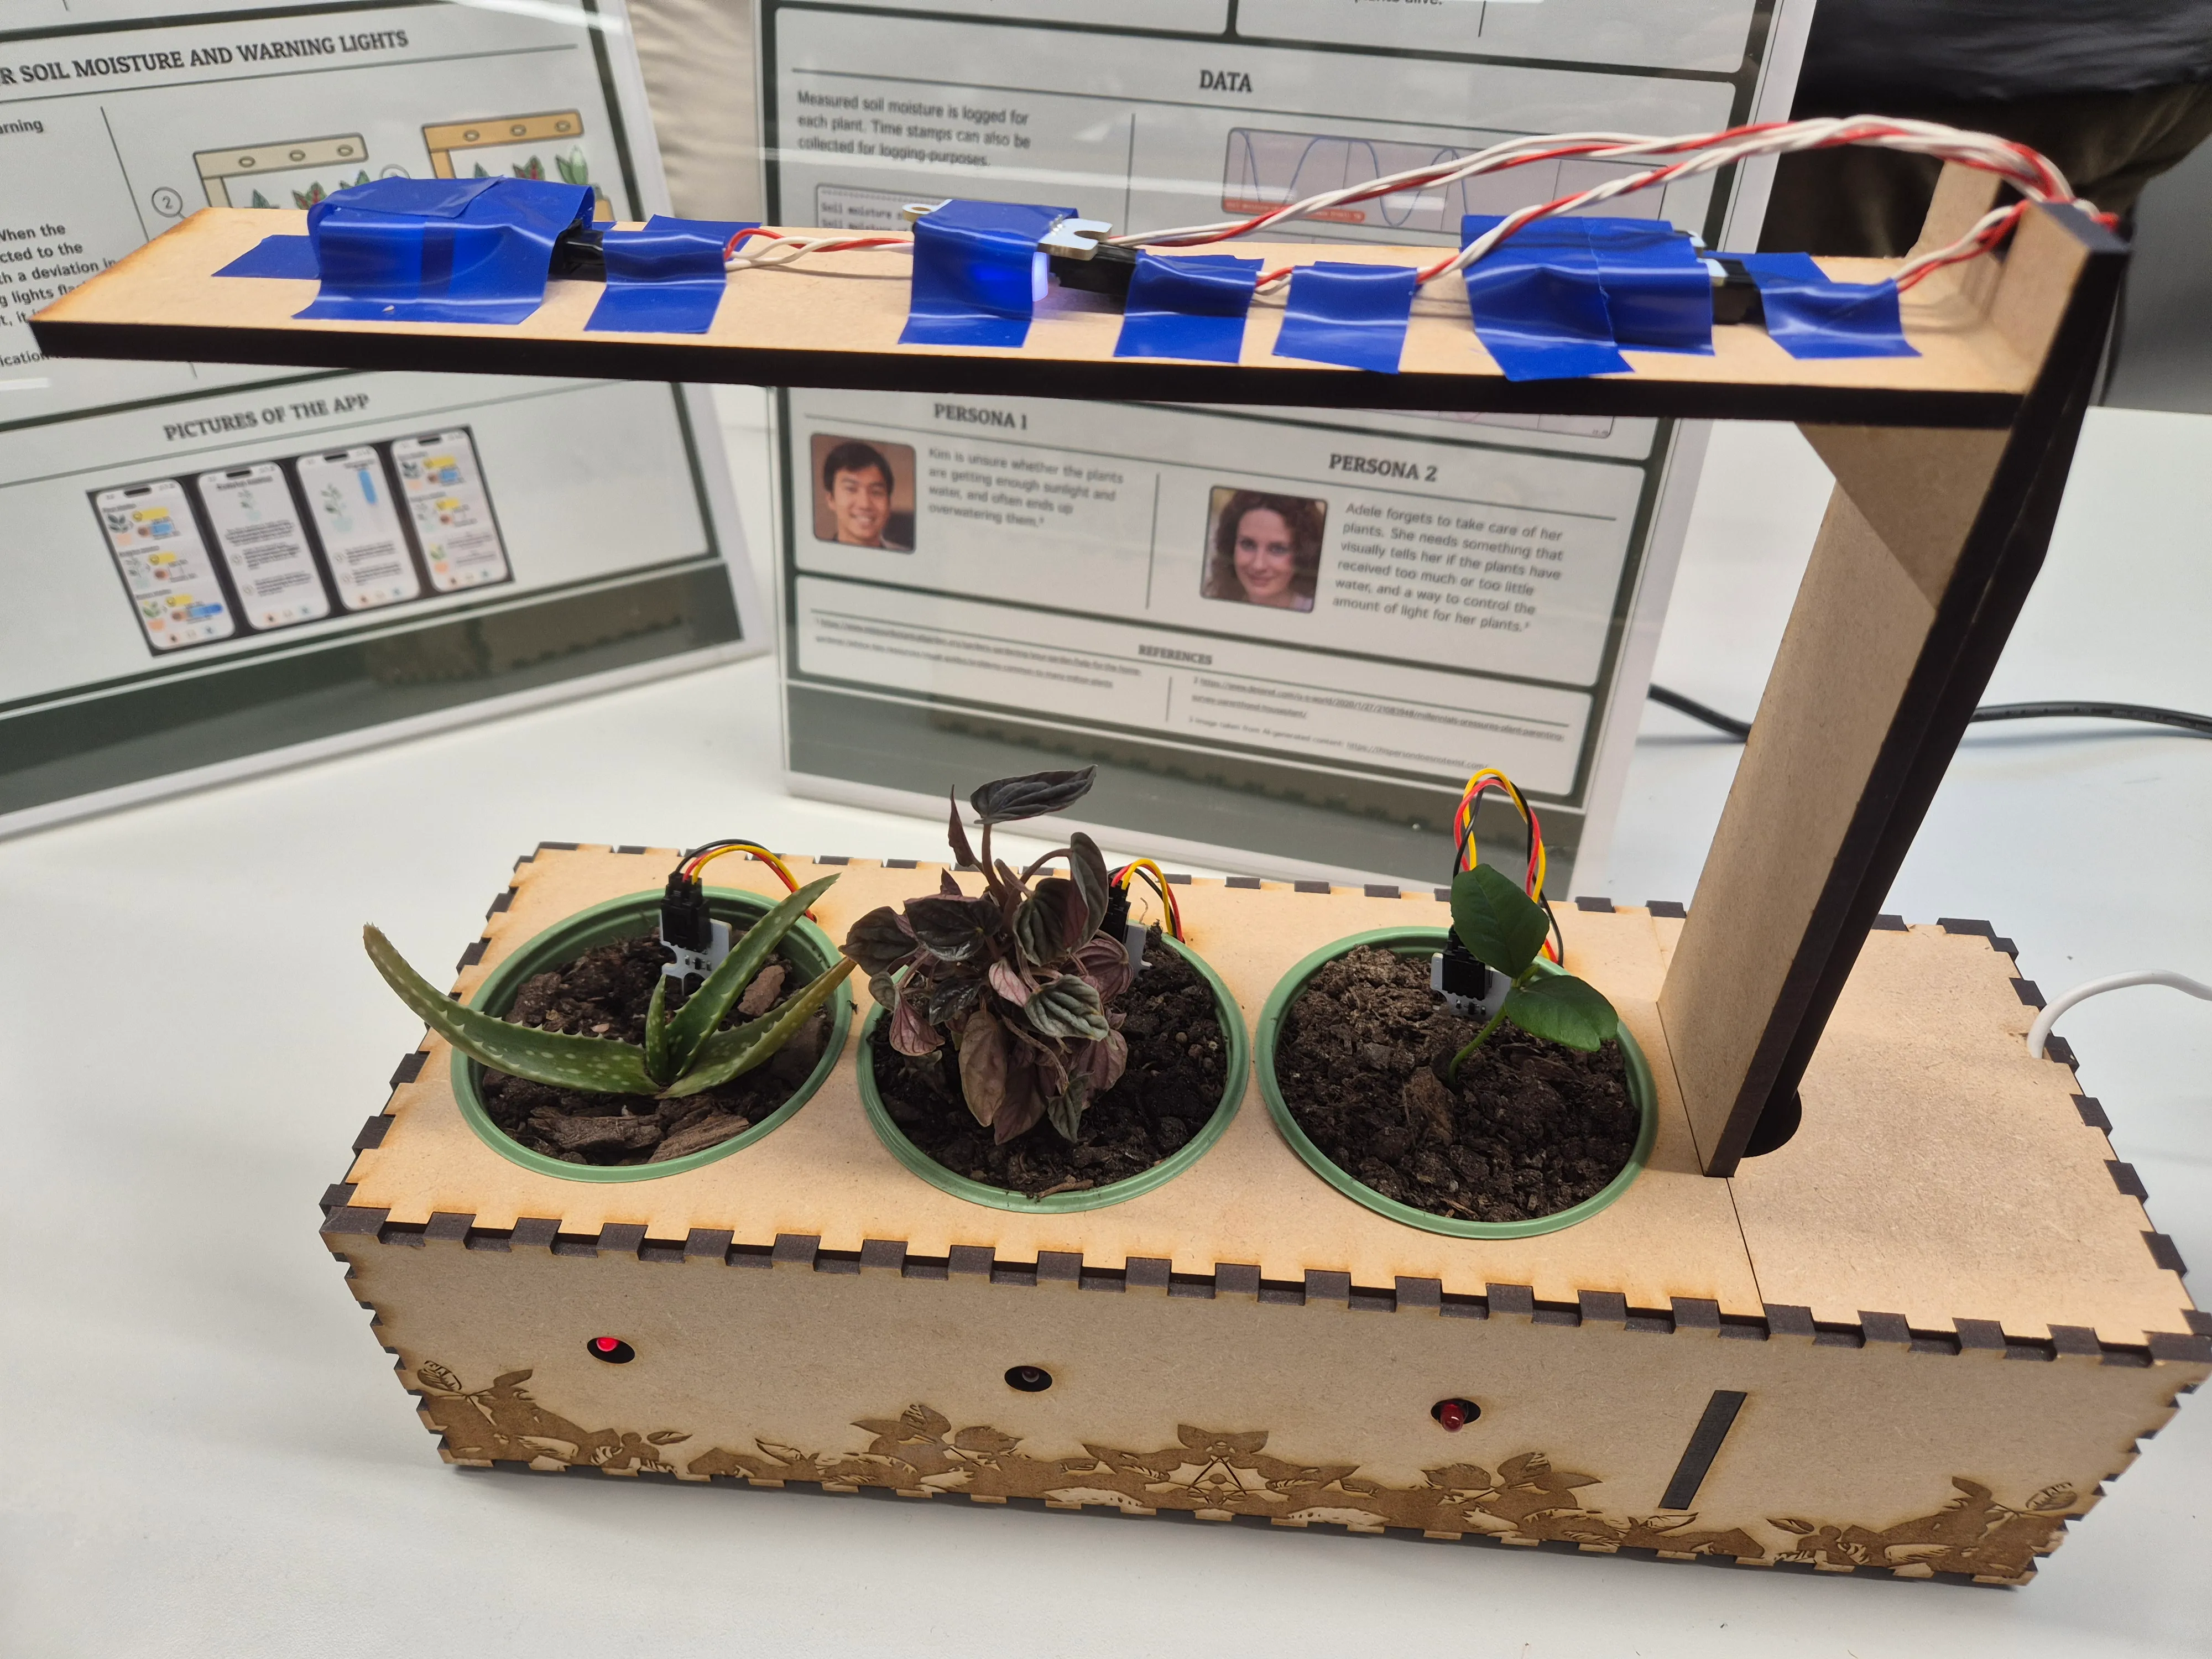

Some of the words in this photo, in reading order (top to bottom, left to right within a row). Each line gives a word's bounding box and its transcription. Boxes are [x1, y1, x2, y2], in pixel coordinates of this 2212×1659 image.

[19, 61, 70, 83] SOIL
[72, 51, 184, 79] MOISTURE
[190, 46, 233, 67] AND
[236, 37, 335, 62] WARNING
[338, 29, 409, 53] LIGHTS
[1199, 69, 1254, 93] DATA
[797, 90, 859, 110] Measured
[862, 97, 884, 111] soil
[888, 100, 943, 117] moisture
[947, 104, 959, 118] is
[962, 105, 1006, 125] logged
[1010, 109, 1029, 126] for
[797, 114, 828, 128] each
[832, 116, 866, 133] plant.
[871, 119, 902, 135] Time
[906, 123, 952, 142] stamps
[956, 129, 979, 144] can
[983, 131, 1010, 146] also
[1013, 133, 1031, 149] be
[797, 135, 854, 153] collected
[857, 139, 875, 155] for
[879, 143, 926, 163] logging
[928, 148, 990, 166] purposes.
[162, 196, 174, 210] 2
[40, 223, 66, 237] the
[37, 247, 54, 259] to
[58, 242, 83, 256] the
[18, 272, 27, 282] a
[32, 261, 100, 280] deviation
[11, 288, 54, 305] lights
[163, 411, 258, 441] PICTURES
[262, 405, 286, 425] OF
[289, 399, 330, 420] THE
[333, 393, 371, 413] APP
[934, 403, 1015, 428] PERSONA
[1021, 414, 1028, 430] 1
[928, 447, 951, 461] Kim
[956, 451, 964, 462] is
[968, 453, 1008, 468] unsure
[1011, 458, 1058, 475] whether
[1062, 464, 1083, 478] the
[1086, 468, 1124, 484] plants
[1328, 452, 1419, 481] PERSONA
[1425, 465, 1437, 482] 2
[928, 468, 947, 478] are
[951, 470, 992, 487] getting
[996, 476, 1040, 492] enough
[1044, 481, 1089, 499] sunlight
[1093, 488, 1117, 502] and
[927, 503, 1003, 525] overwatering
[928, 486, 963, 500] water,
[967, 489, 988, 502] and
[992, 492, 1023, 507] often
[1025, 497, 1055, 513] ends
[1057, 502, 1074, 517] up
[1345, 502, 1382, 518] Adele
[1386, 507, 1433, 525] forgets
[1437, 516, 1451, 527] to
[1456, 517, 1485, 531] take
[1489, 523, 1518, 536] care
[1522, 525, 1537, 538] of
[1540, 527, 1563, 541] her
[1343, 522, 1385, 538] plants.
[1390, 526, 1415, 541] She
[1418, 531, 1458, 547] needs
[1462, 538, 1531, 560] something
[1536, 547, 1564, 561] that
[1340, 541, 1386, 558] visually
[1390, 546, 1416, 562] tells
[1421, 550, 1442, 565] her
[1446, 554, 1457, 566] if
[1459, 555, 1481, 570] the
[1485, 560, 1525, 576] plants
[1529, 565, 1562, 581] have
[1338, 559, 1391, 577] received
[1395, 566, 1416, 580] too
[1421, 571, 1455, 586] much
[1460, 576, 1474, 588] or
[1479, 576, 1501, 592] too
[1505, 581, 1535, 597] little
[1332, 596, 1380, 613] amount
[1383, 602, 1397, 614] of
[1400, 604, 1428, 620] light
[1432, 608, 1451, 623] for
[1454, 611, 1477, 625] her
[1335, 578, 1371, 594] water,
[1376, 585, 1400, 597] and
[1404, 588, 1412, 598] a
[1416, 589, 1442, 604] way
[1446, 592, 1459, 604] to
[1463, 595, 1510, 612] control
[1514, 601, 1536, 616] the
[1138, 644, 1212, 665] REFERENCES
